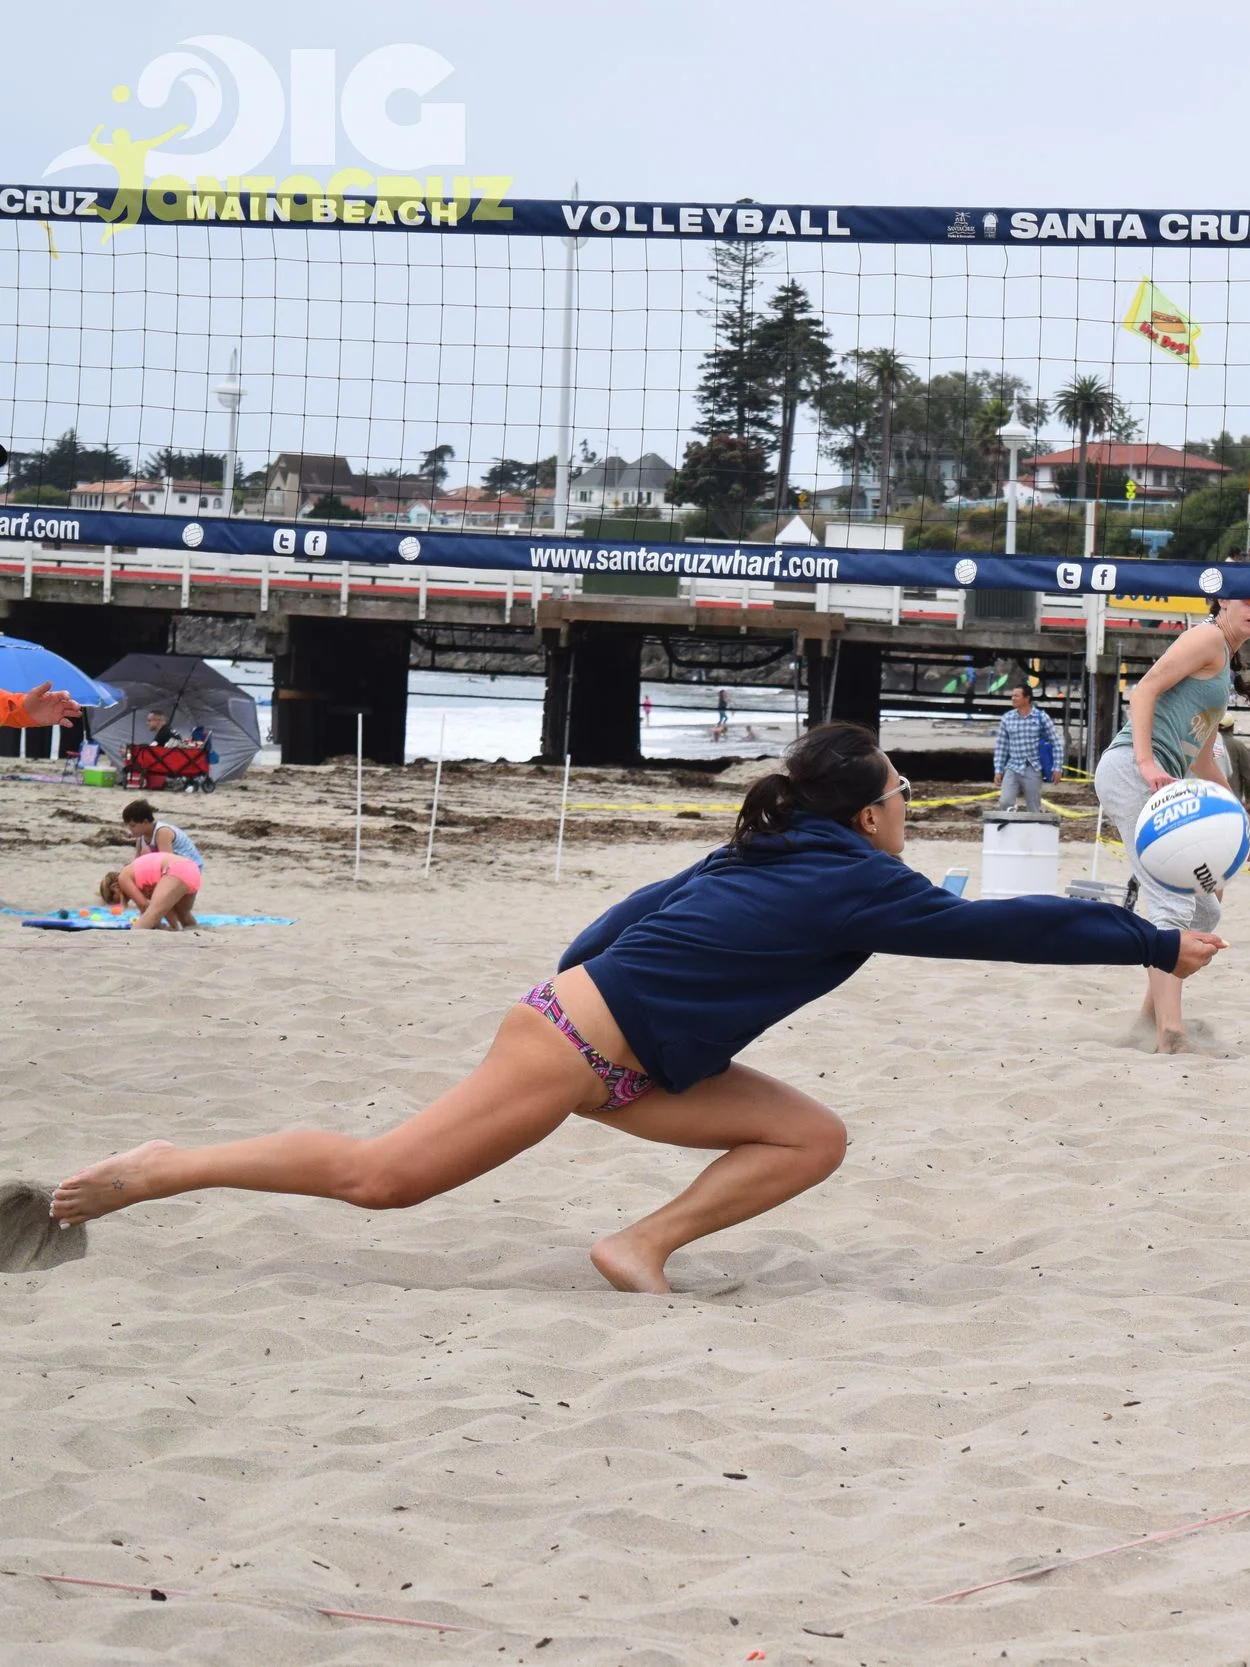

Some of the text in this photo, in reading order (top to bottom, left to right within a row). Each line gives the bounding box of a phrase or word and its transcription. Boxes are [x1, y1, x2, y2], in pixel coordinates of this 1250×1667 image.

[0, 188, 851, 236] CRUZ MAIN BEACH VOLLEYBALL
[1010, 211, 1147, 240] SANTA
[530, 547, 839, 578] www.santacruzwharf.com
[1153, 797, 1200, 832] SAND
